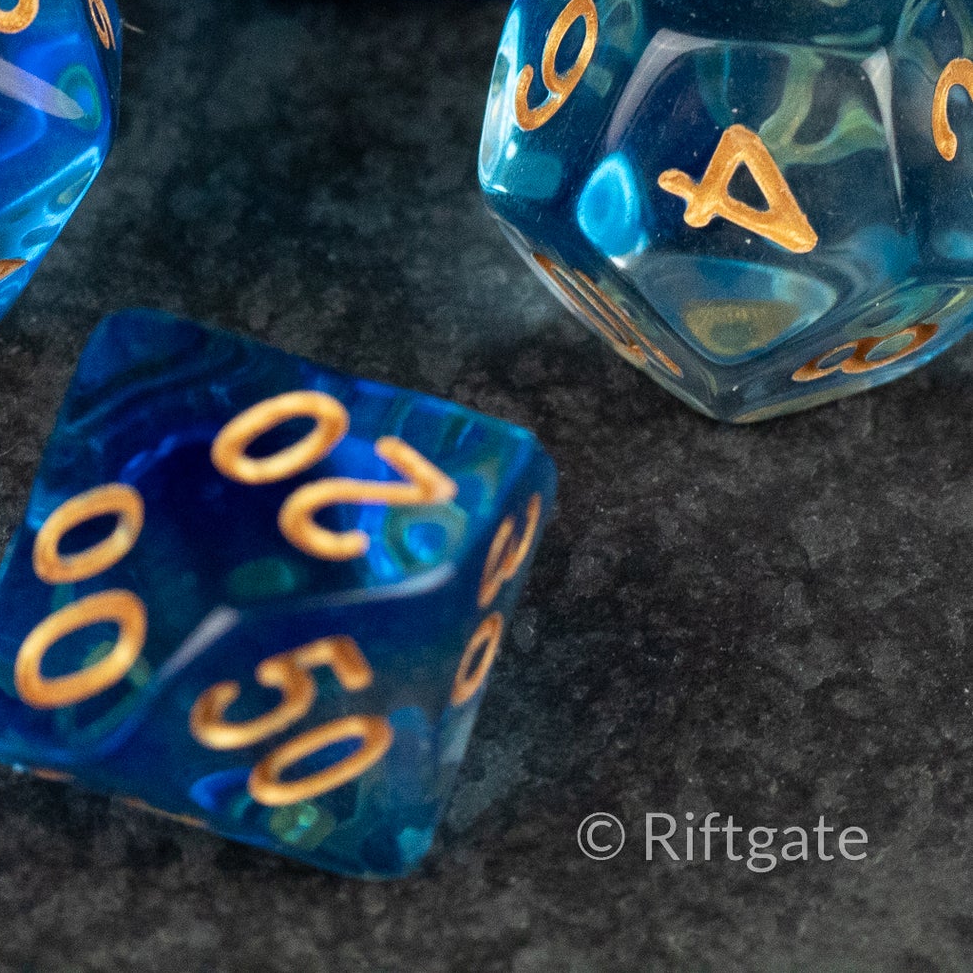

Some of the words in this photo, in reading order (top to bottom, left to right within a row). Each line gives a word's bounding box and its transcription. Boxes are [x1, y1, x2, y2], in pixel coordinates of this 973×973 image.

[657, 124, 818, 253] 4
[210, 390, 459, 562] 20
[13, 482, 147, 709] 00
[189, 634, 394, 807] 50
